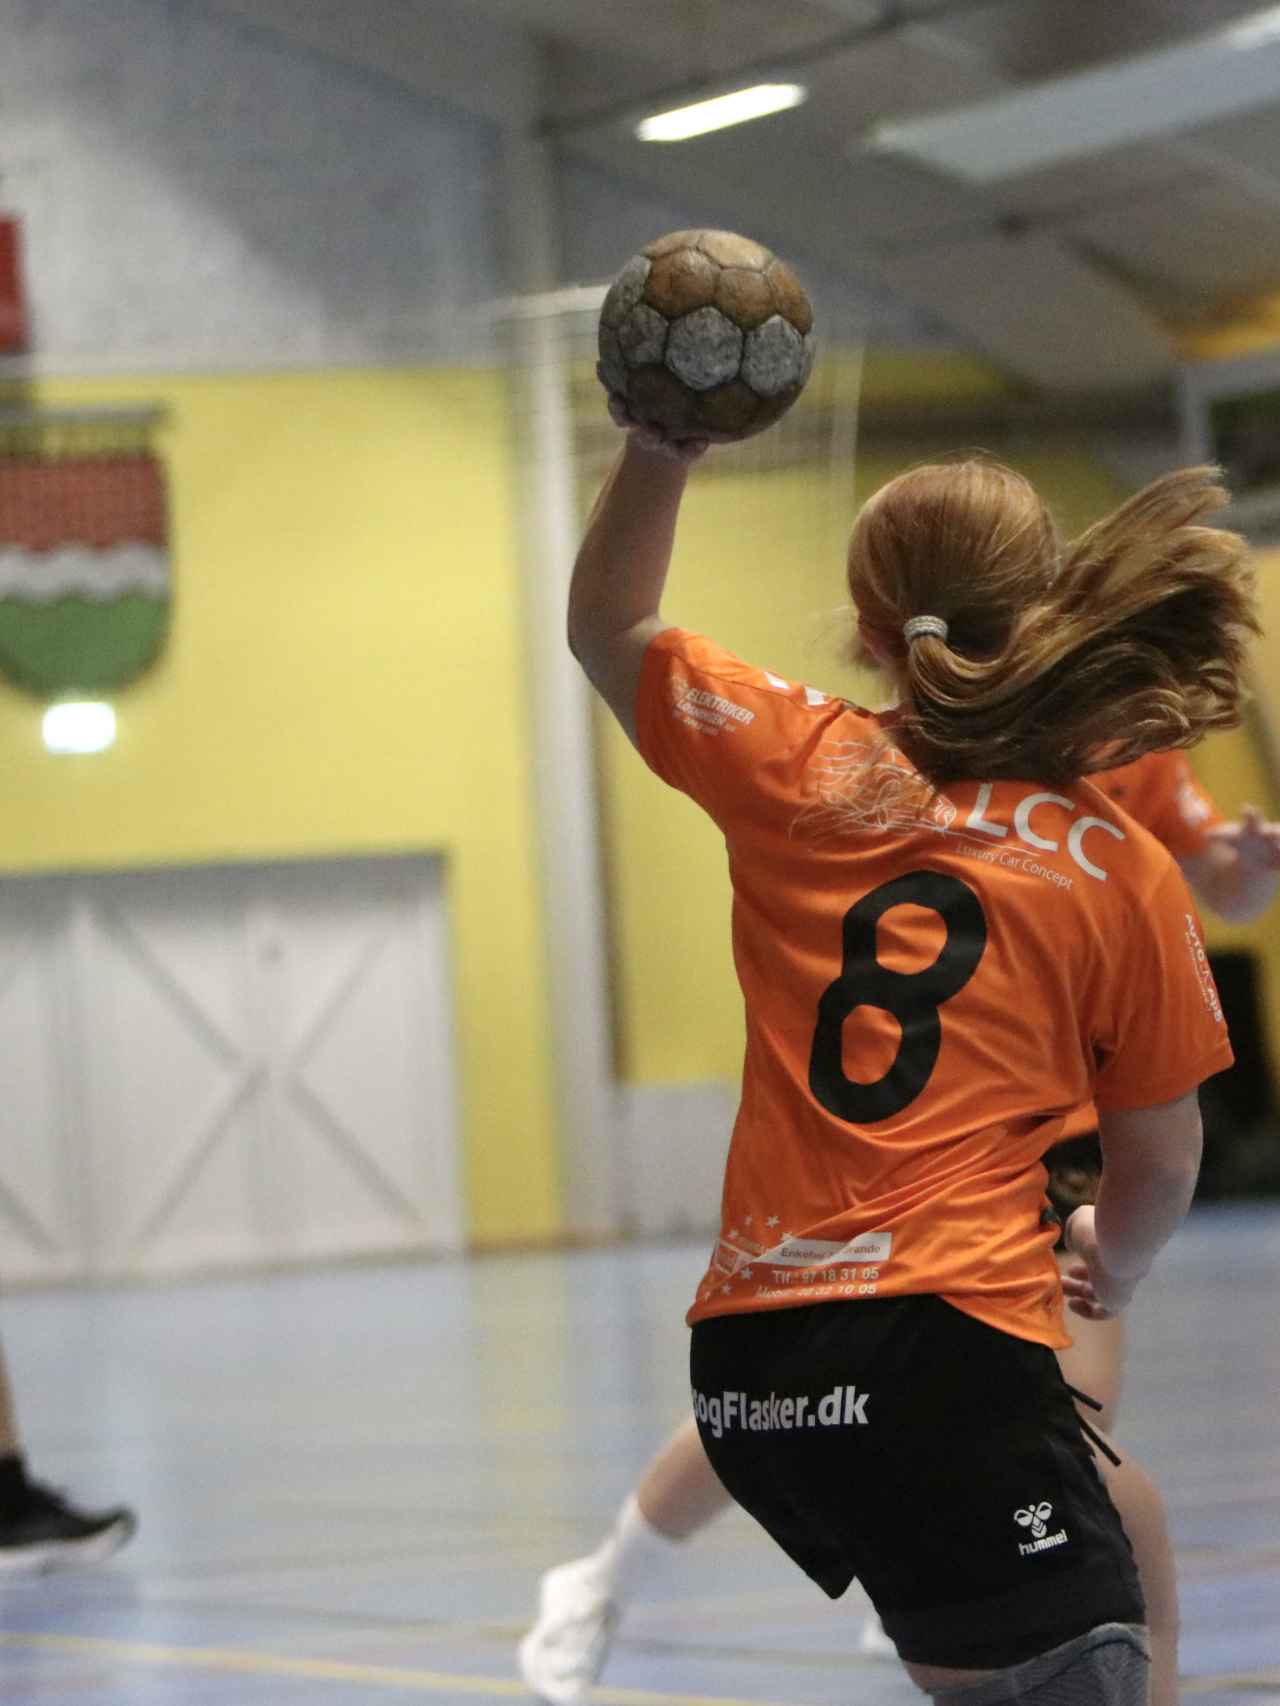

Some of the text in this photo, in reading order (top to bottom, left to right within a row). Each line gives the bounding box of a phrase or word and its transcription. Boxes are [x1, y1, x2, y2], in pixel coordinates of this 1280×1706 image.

[966, 783, 1126, 882] LCC
[956, 842, 1073, 891] Luxury Car Concept
[808, 869, 988, 1124] 8
[822, 1269, 836, 1281] 18
[840, 1267, 857, 1281] 31
[861, 1265, 880, 1280] 05
[858, 1283, 877, 1295] 05
[1018, 1528, 1068, 1556] hummel
